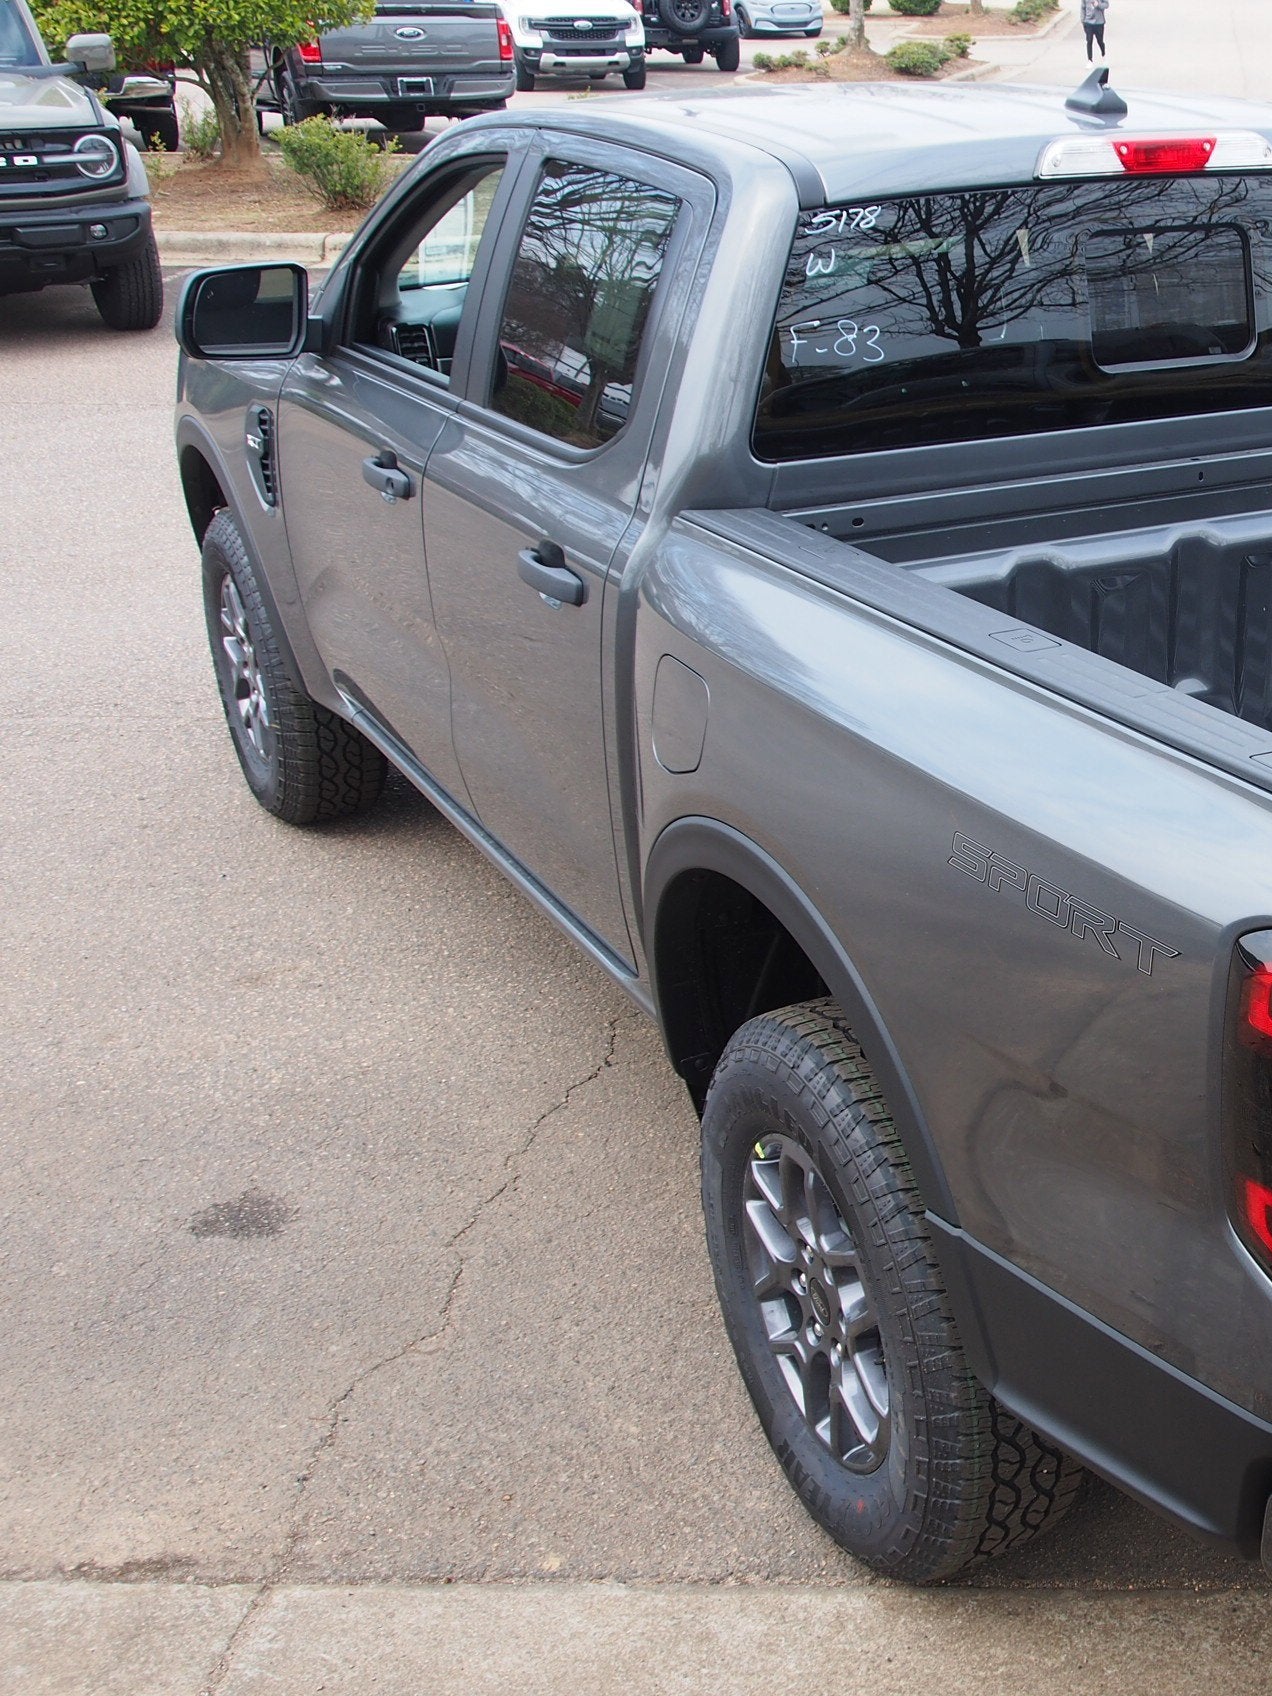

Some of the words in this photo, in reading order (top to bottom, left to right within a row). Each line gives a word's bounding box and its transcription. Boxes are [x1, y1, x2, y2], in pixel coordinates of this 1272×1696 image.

[805, 205, 882, 235] 5178
[790, 319, 885, 363] F-83
[947, 831, 1182, 976] SPORT
